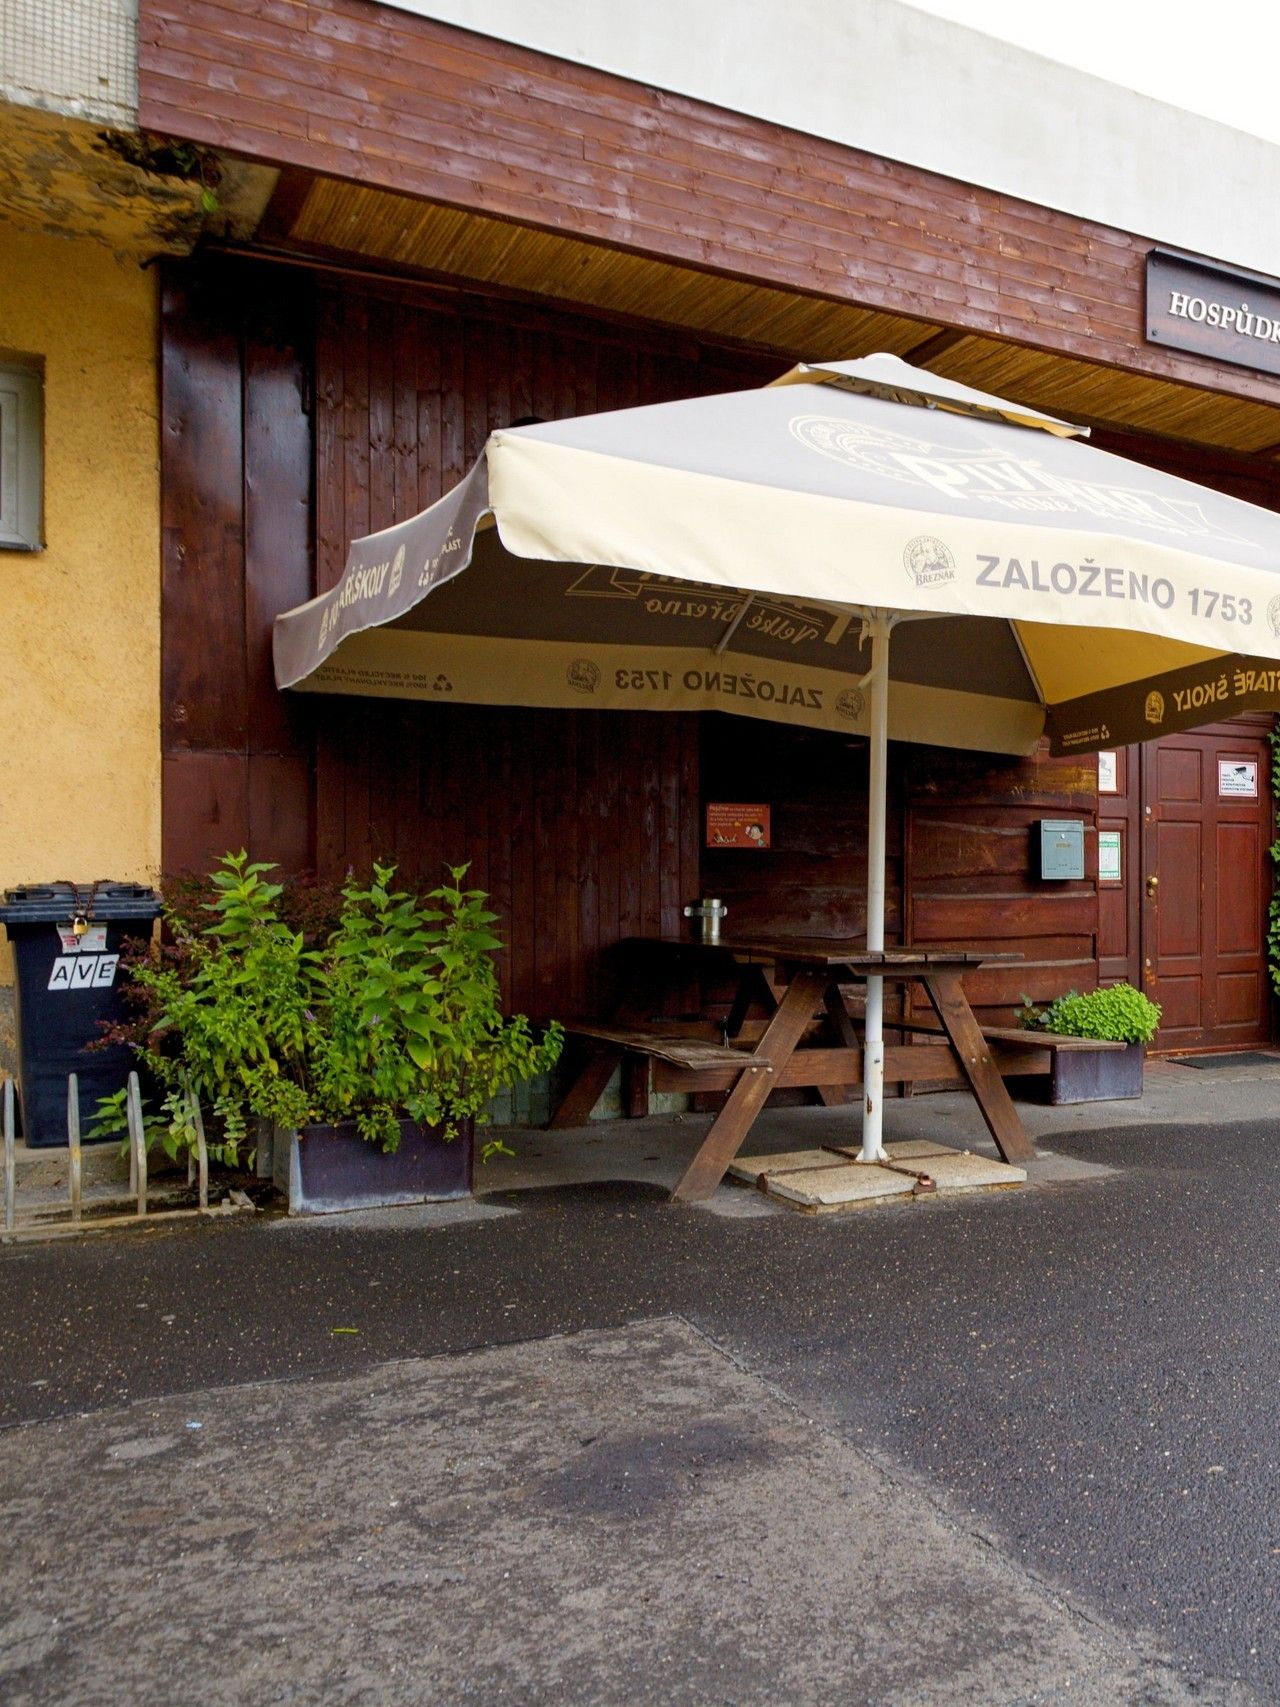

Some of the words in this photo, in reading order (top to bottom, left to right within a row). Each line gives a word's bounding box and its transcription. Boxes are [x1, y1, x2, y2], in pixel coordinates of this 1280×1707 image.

[975, 554, 1176, 610] ZALOŽENO
[1187, 587, 1254, 626] 1753
[53, 961, 114, 982] AVE
